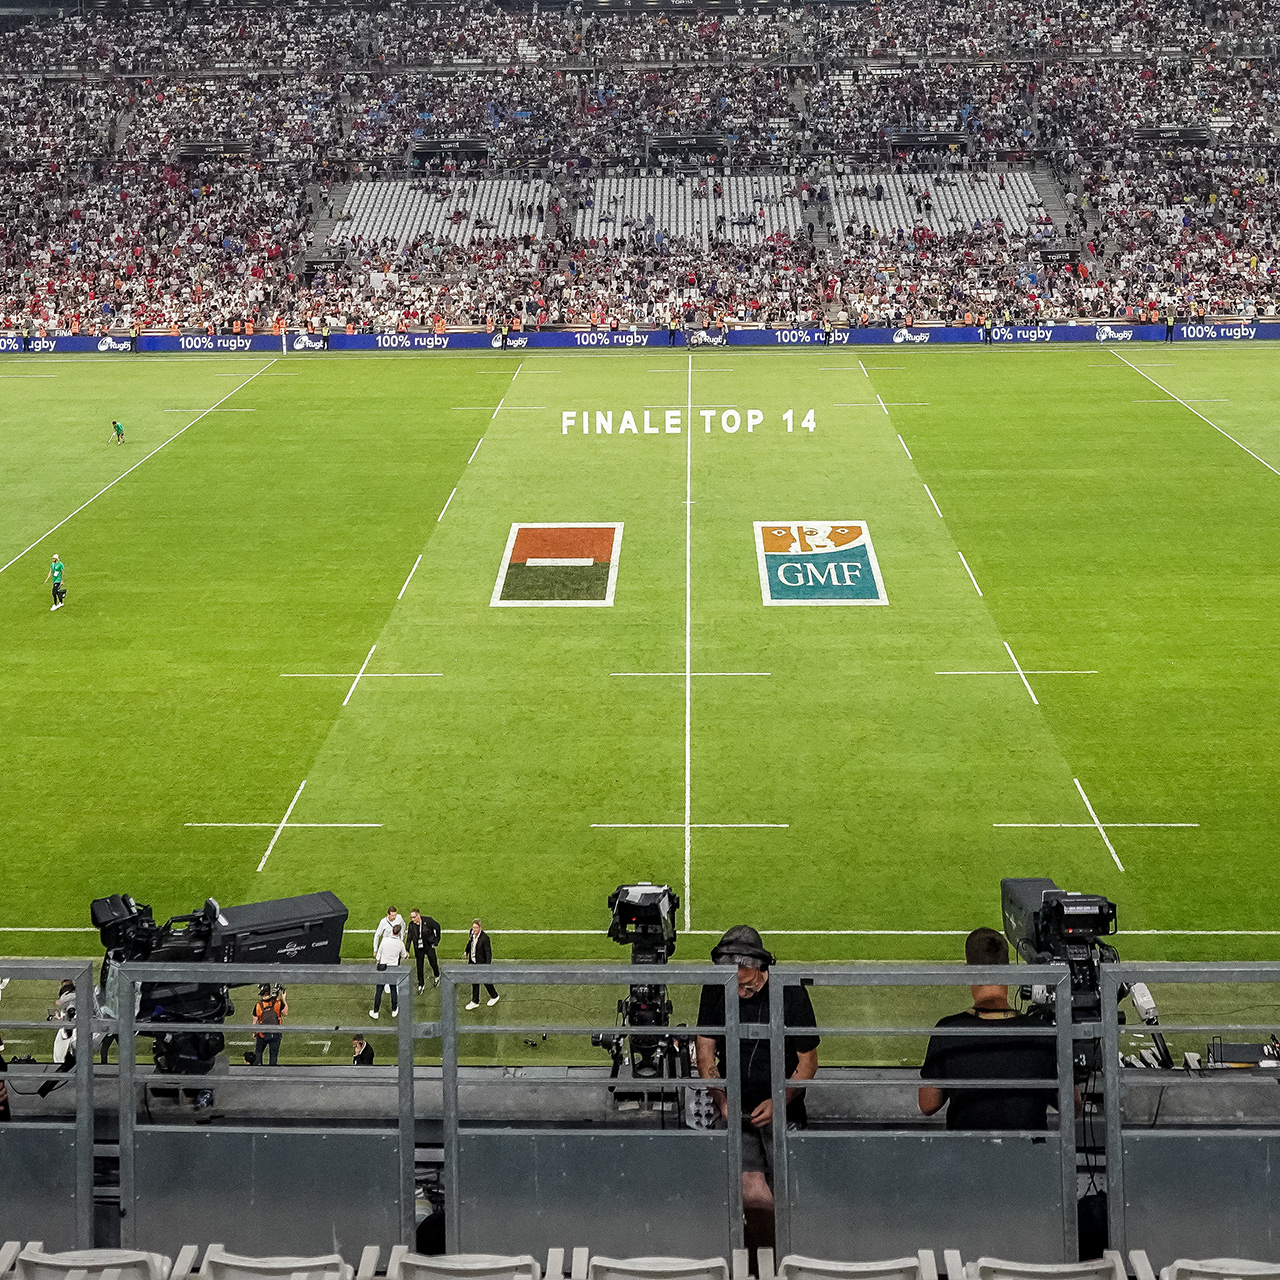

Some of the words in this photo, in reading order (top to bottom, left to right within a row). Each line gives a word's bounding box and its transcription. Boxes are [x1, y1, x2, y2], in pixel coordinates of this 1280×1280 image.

[575, 333, 610, 346] 100%
[613, 332, 649, 346] rugby
[775, 331, 811, 343] 100%
[906, 332, 930, 343] Rugby
[977, 328, 1013, 340] 10%
[1017, 327, 1052, 341] rugby
[1108, 330, 1133, 340] Rugby
[1181, 326, 1217, 338] 100%
[1220, 325, 1256, 339] rugby
[23, 337, 57, 352] ugby
[179, 336, 213, 349] 100%
[217, 336, 252, 350] rugby
[376, 335, 411, 348] 100%
[414, 334, 449, 348] rugby
[562, 410, 682, 434] FINALE
[699, 409, 764, 434] TOP
[782, 408, 817, 433] 14
[777, 562, 862, 587] GMF
